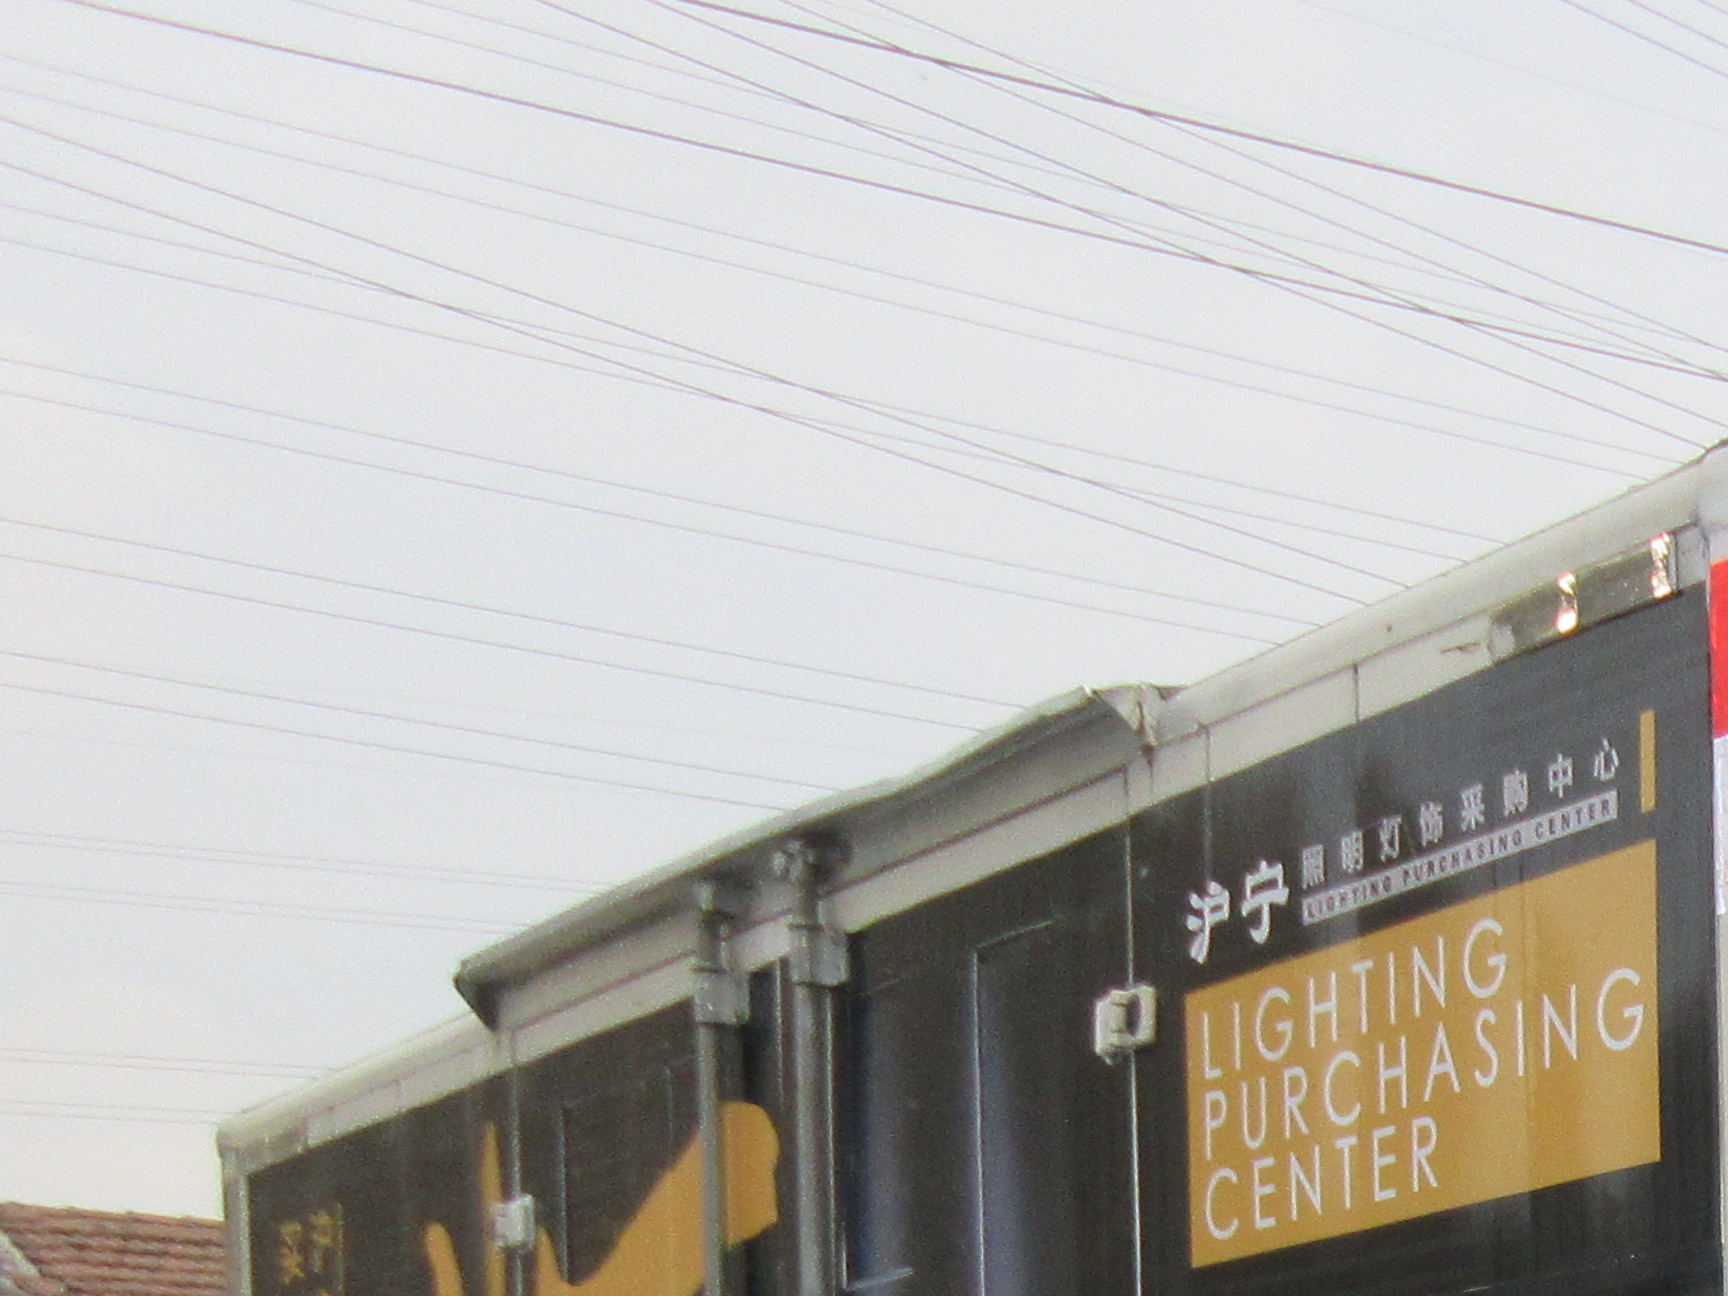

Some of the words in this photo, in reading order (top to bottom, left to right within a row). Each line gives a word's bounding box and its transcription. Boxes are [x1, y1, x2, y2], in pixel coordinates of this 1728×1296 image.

[1186, 860, 1290, 963] 沪宁
[1305, 877, 1393, 921] LIGHTING
[1402, 828, 1523, 884] PURCHASING
[1535, 798, 1613, 840] CENTER
[1203, 918, 1507, 1079] LIGHTING
[1204, 968, 1644, 1160] PURCHASING
[1204, 1116, 1438, 1239] CENTER
